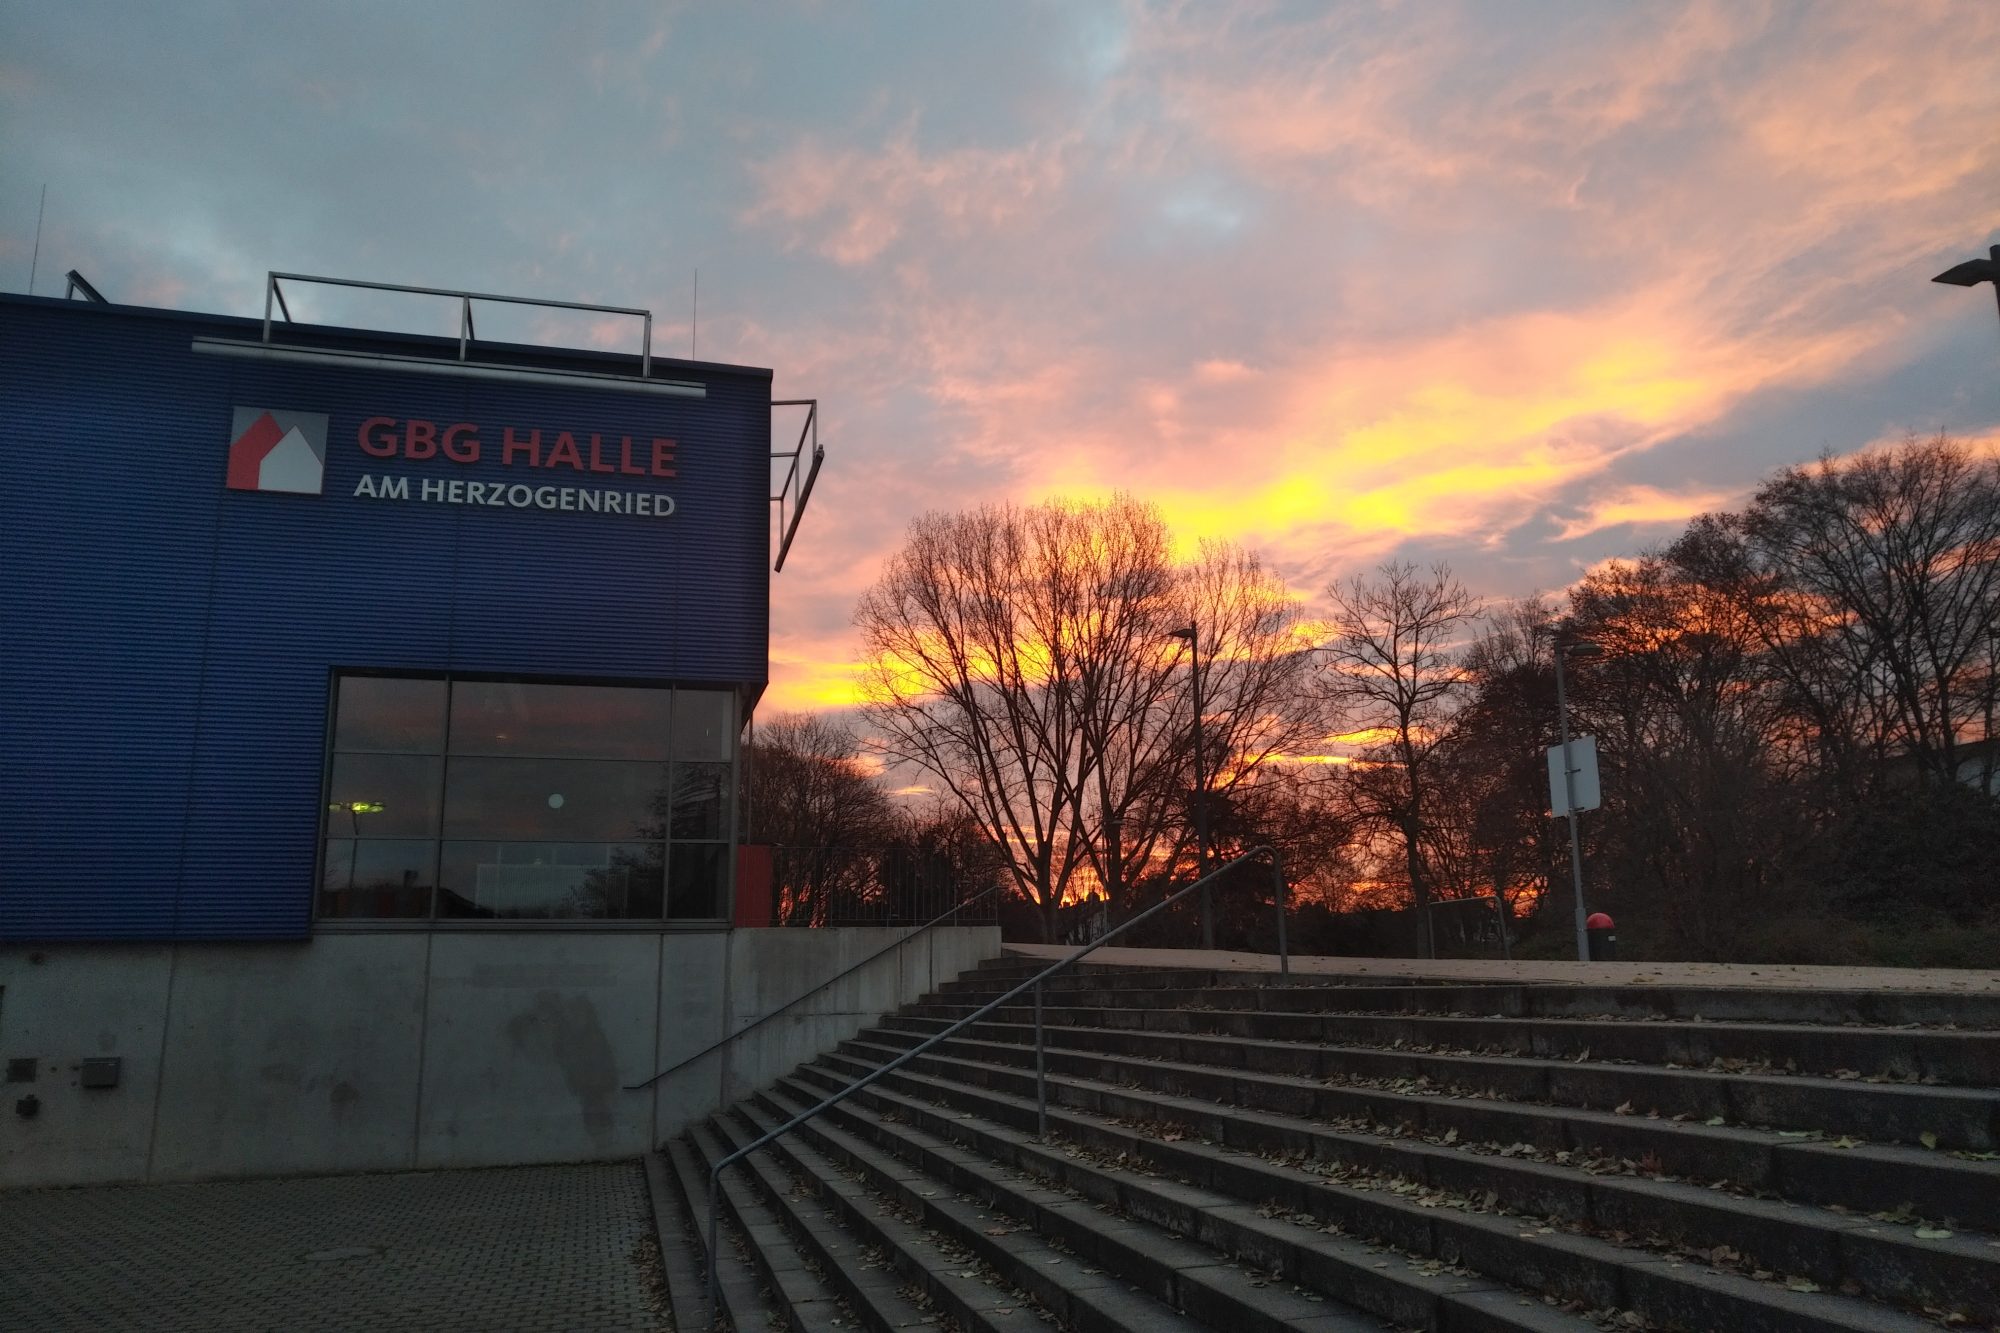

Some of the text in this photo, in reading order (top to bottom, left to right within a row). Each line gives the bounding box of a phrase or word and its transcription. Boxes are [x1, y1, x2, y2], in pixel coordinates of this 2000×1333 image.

[357, 416, 678, 477] GBG HALLE
[353, 474, 676, 517] AM HERZOGENRIED
